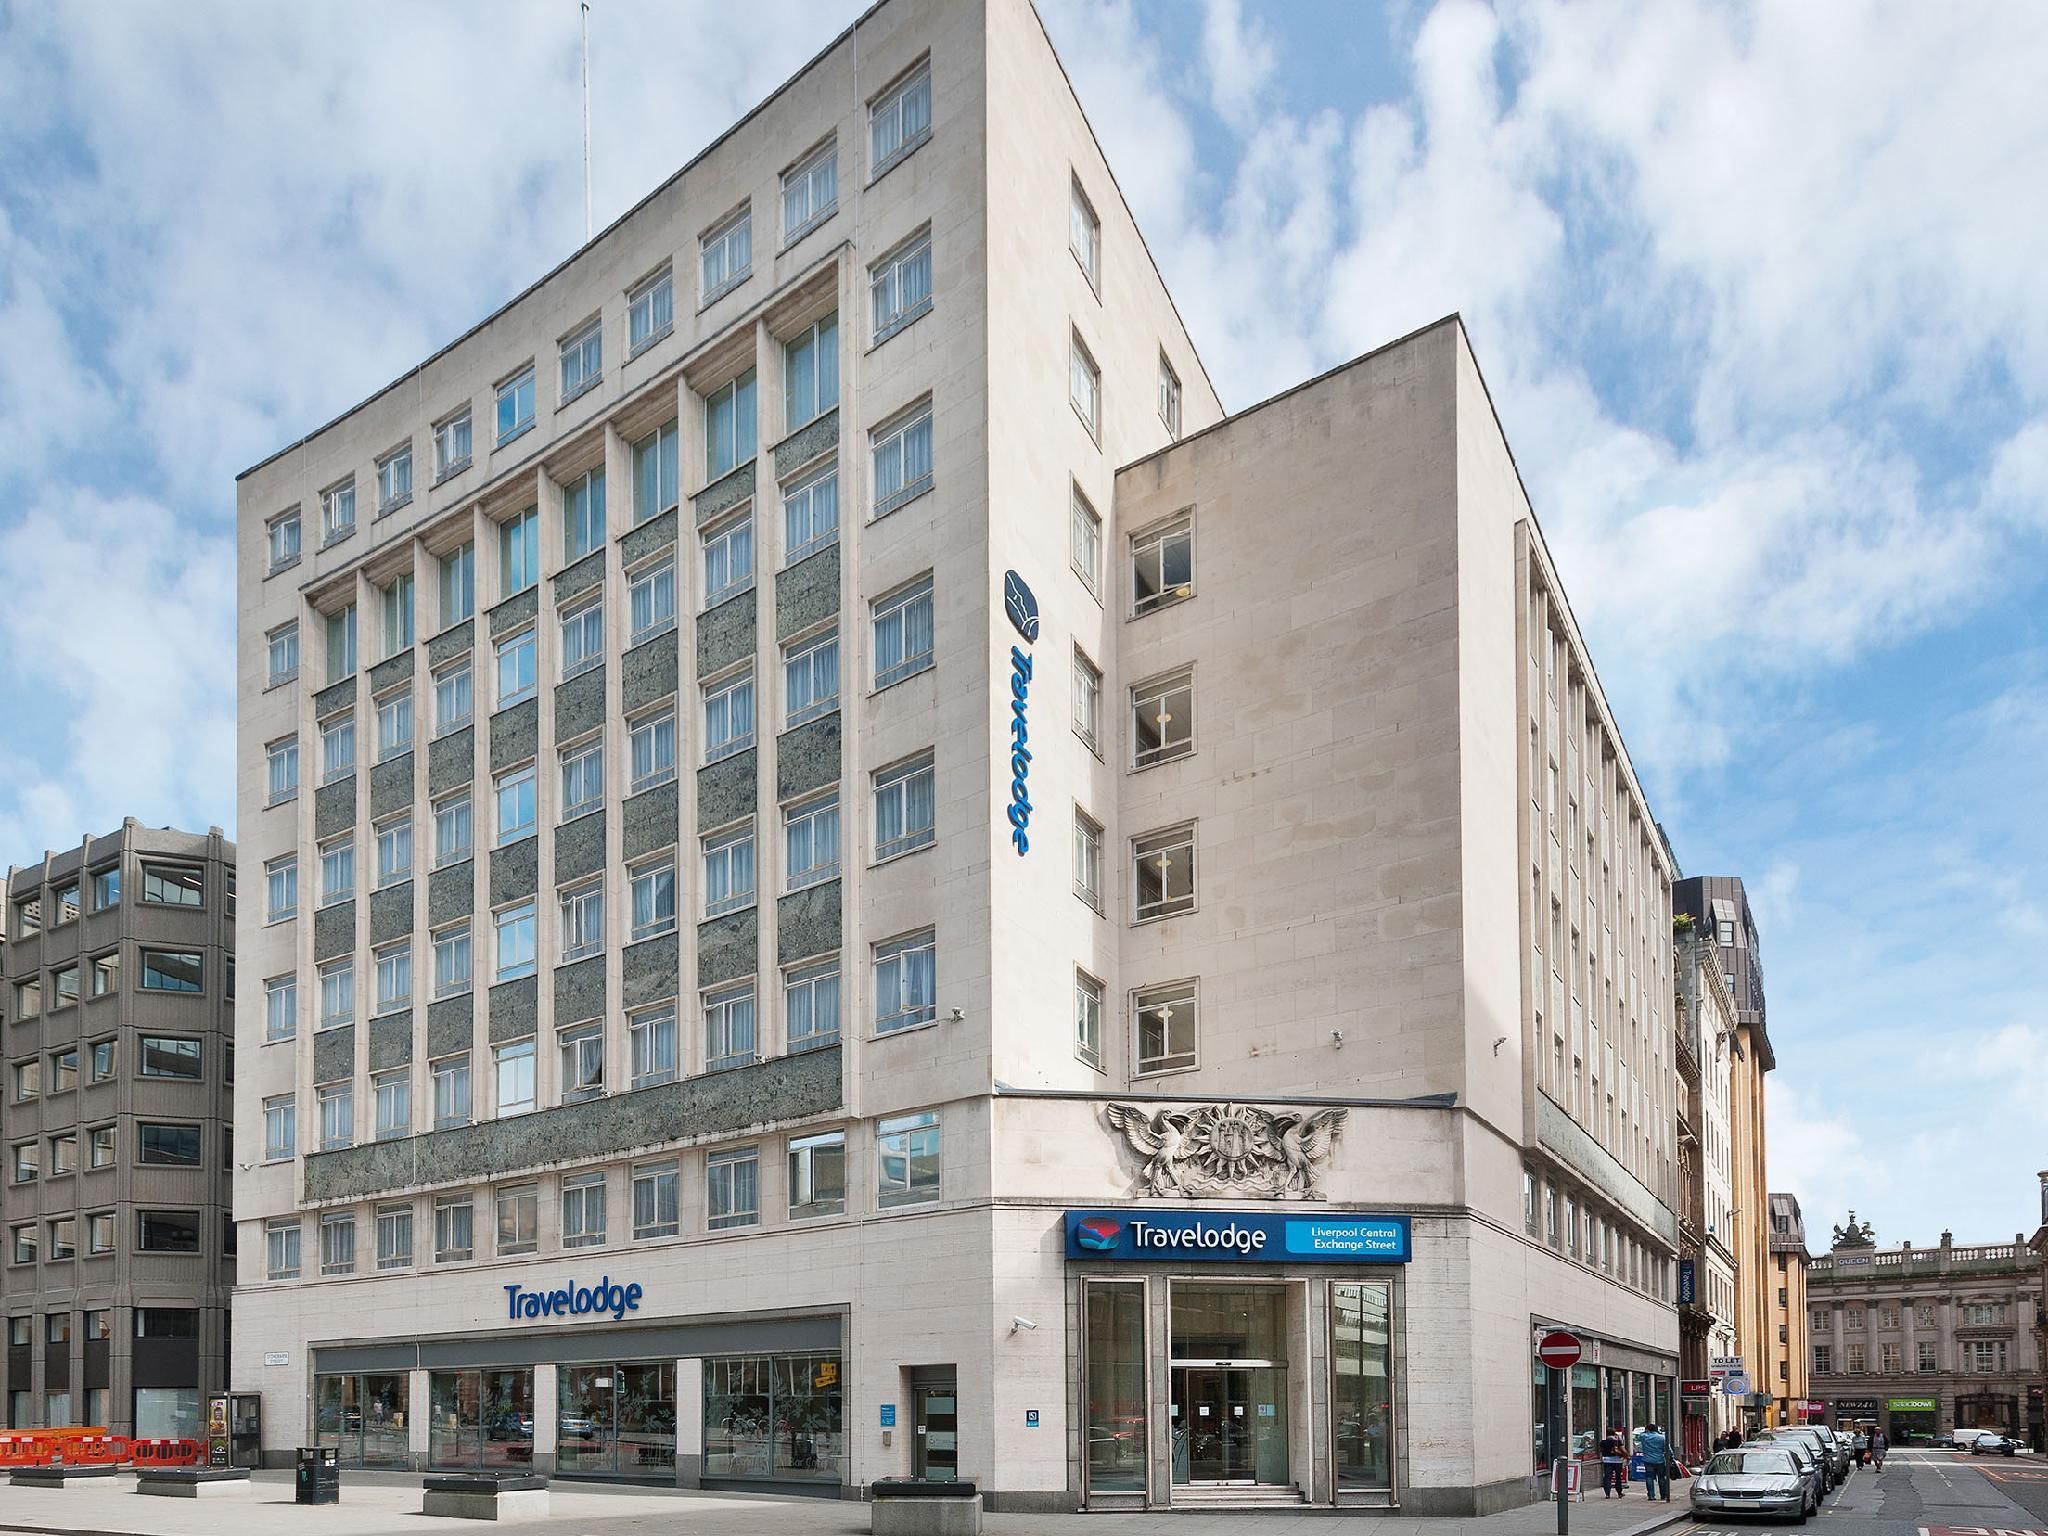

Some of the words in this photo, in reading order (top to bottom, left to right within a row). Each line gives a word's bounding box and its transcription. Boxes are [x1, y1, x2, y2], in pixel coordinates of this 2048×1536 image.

[1008, 645, 1033, 857] Travelodge
[1129, 1221, 1267, 1254] Travelodge
[1311, 1227, 1358, 1239] Liverpool
[1360, 1228, 1396, 1238] Central
[1314, 1239, 1364, 1251] Exchange
[1365, 1240, 1397, 1250] Street
[503, 1275, 643, 1320] Travelodge
